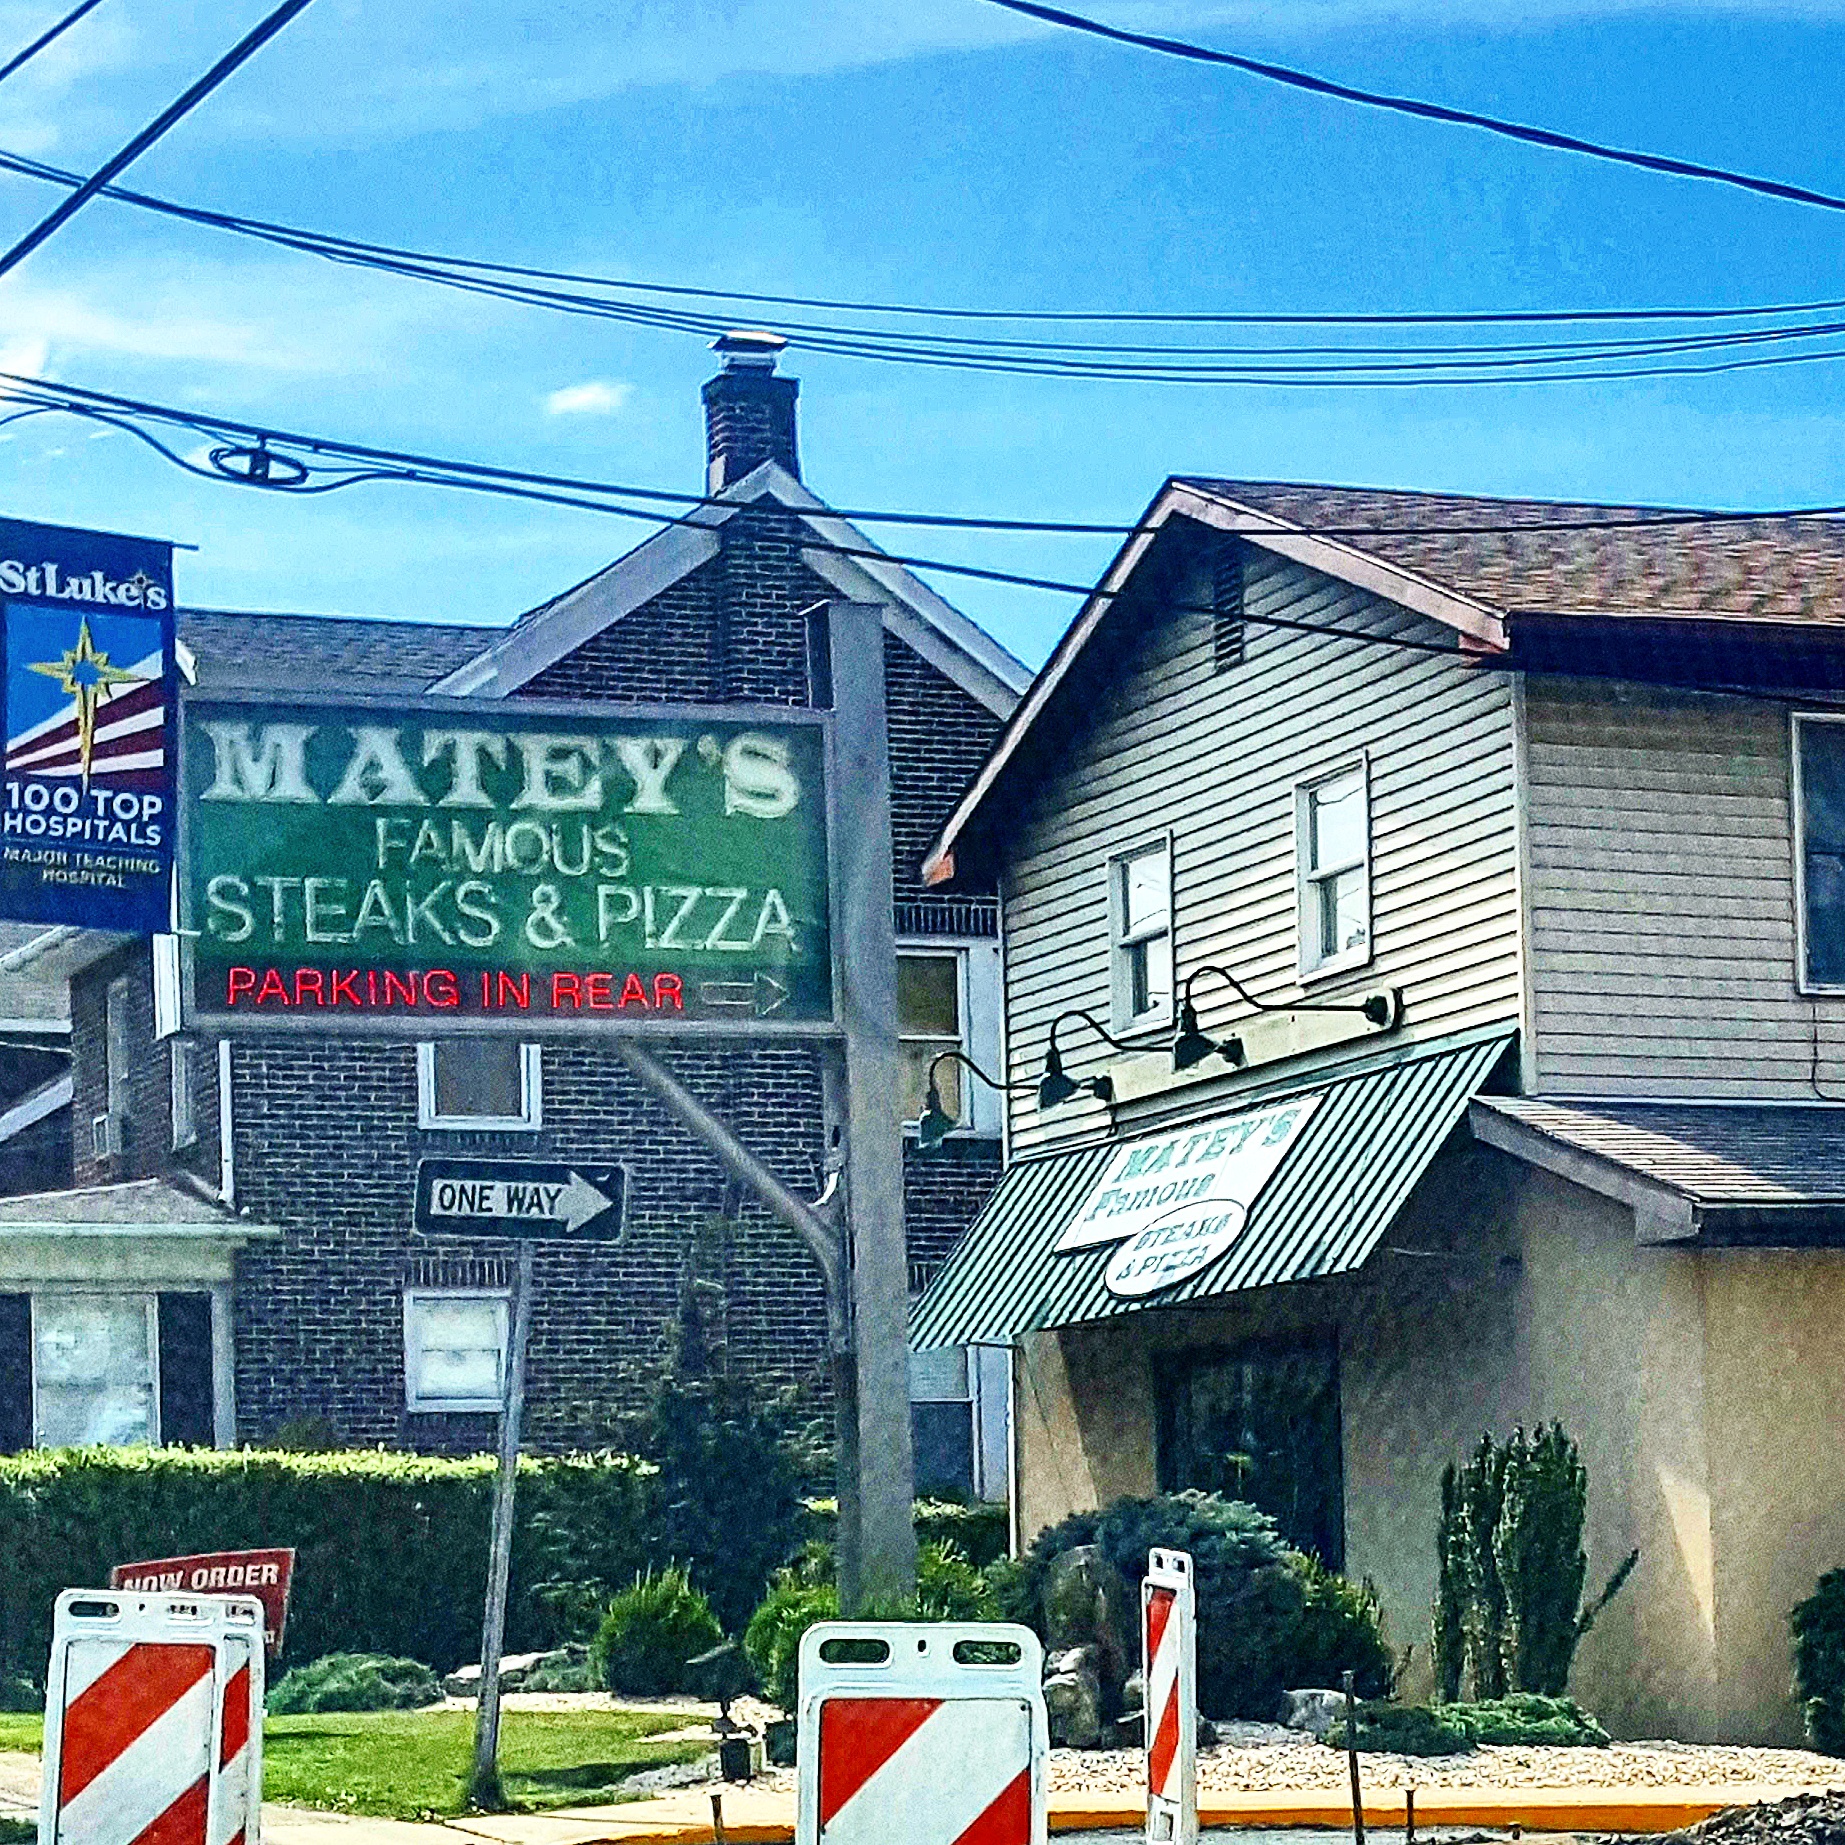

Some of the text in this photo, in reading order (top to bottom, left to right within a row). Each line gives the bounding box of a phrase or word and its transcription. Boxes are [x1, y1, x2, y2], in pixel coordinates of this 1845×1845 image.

[200, 722, 799, 818] MATEY'S
[6, 782, 163, 821] 100 TOP
[3, 811, 161, 846] HOSPITALS
[4, 847, 161, 873] MAJOR TEACHING
[375, 819, 631, 876] FAMOUS
[42, 869, 127, 888] HOSPITAL
[207, 875, 800, 952] STEAKS & PIZZA
[227, 967, 685, 1010] PARKING IN REAR
[439, 1184, 562, 1216] ONE WAY
[191, 1564, 280, 1590] ORDER
